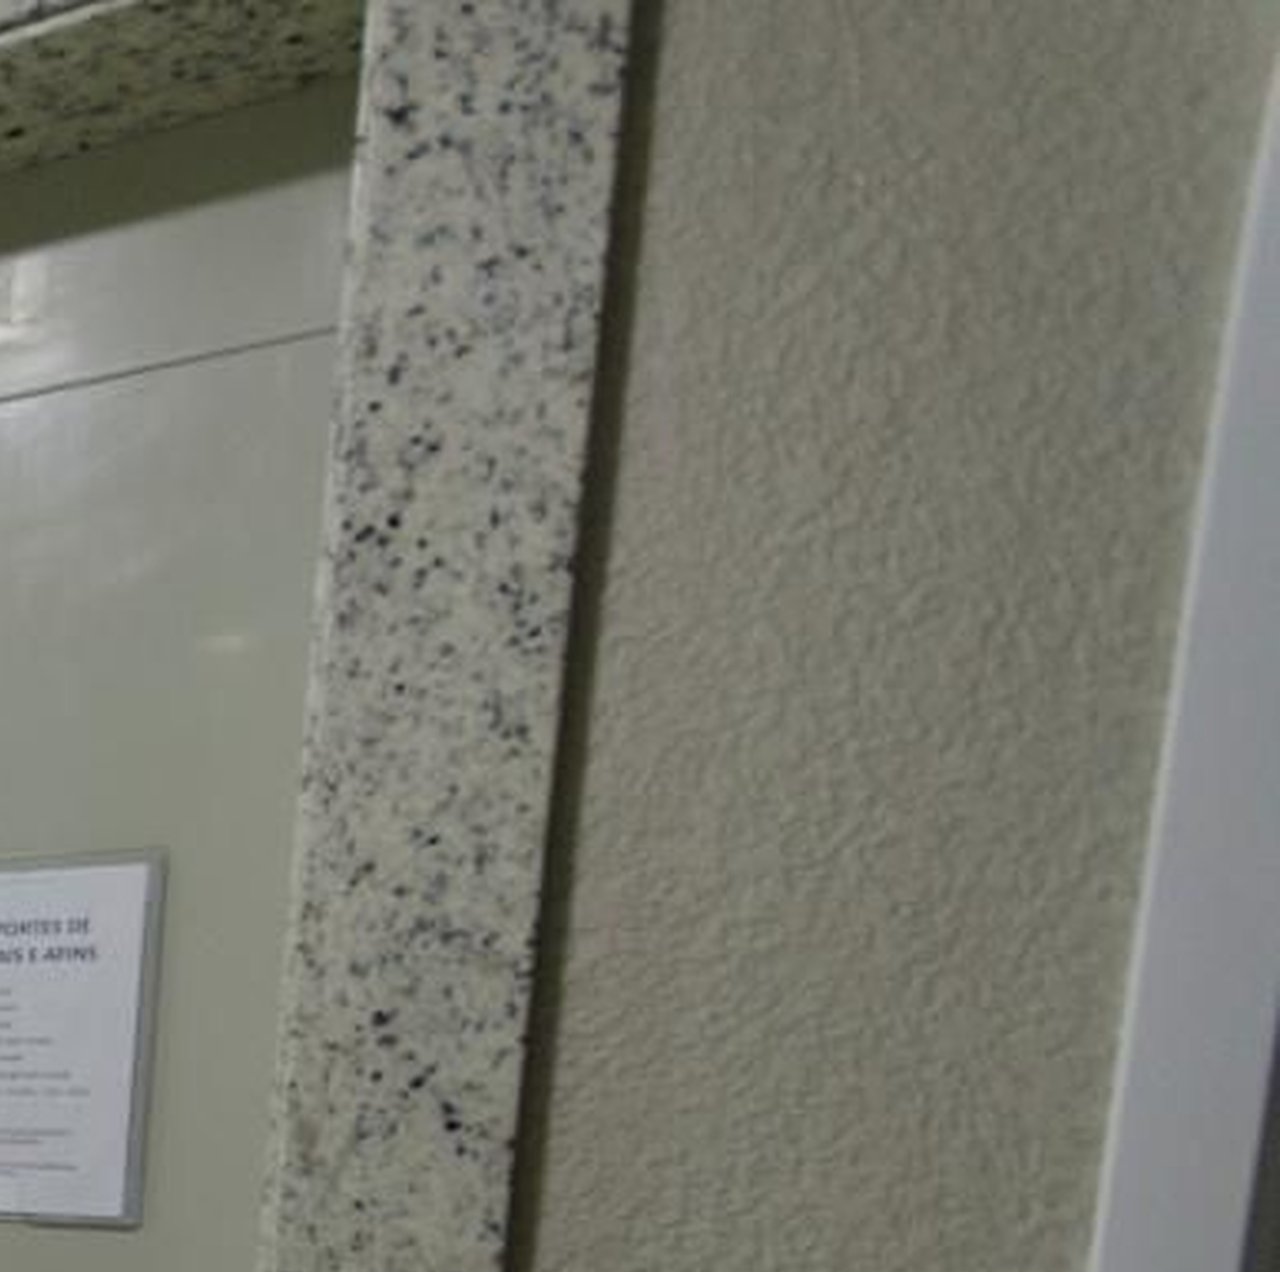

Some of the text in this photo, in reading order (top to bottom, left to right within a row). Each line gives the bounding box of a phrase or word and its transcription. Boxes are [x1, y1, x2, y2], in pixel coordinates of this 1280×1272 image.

[66, 917, 90, 934] DE
[28, 947, 39, 963] E
[42, 945, 98, 963] AFINS
